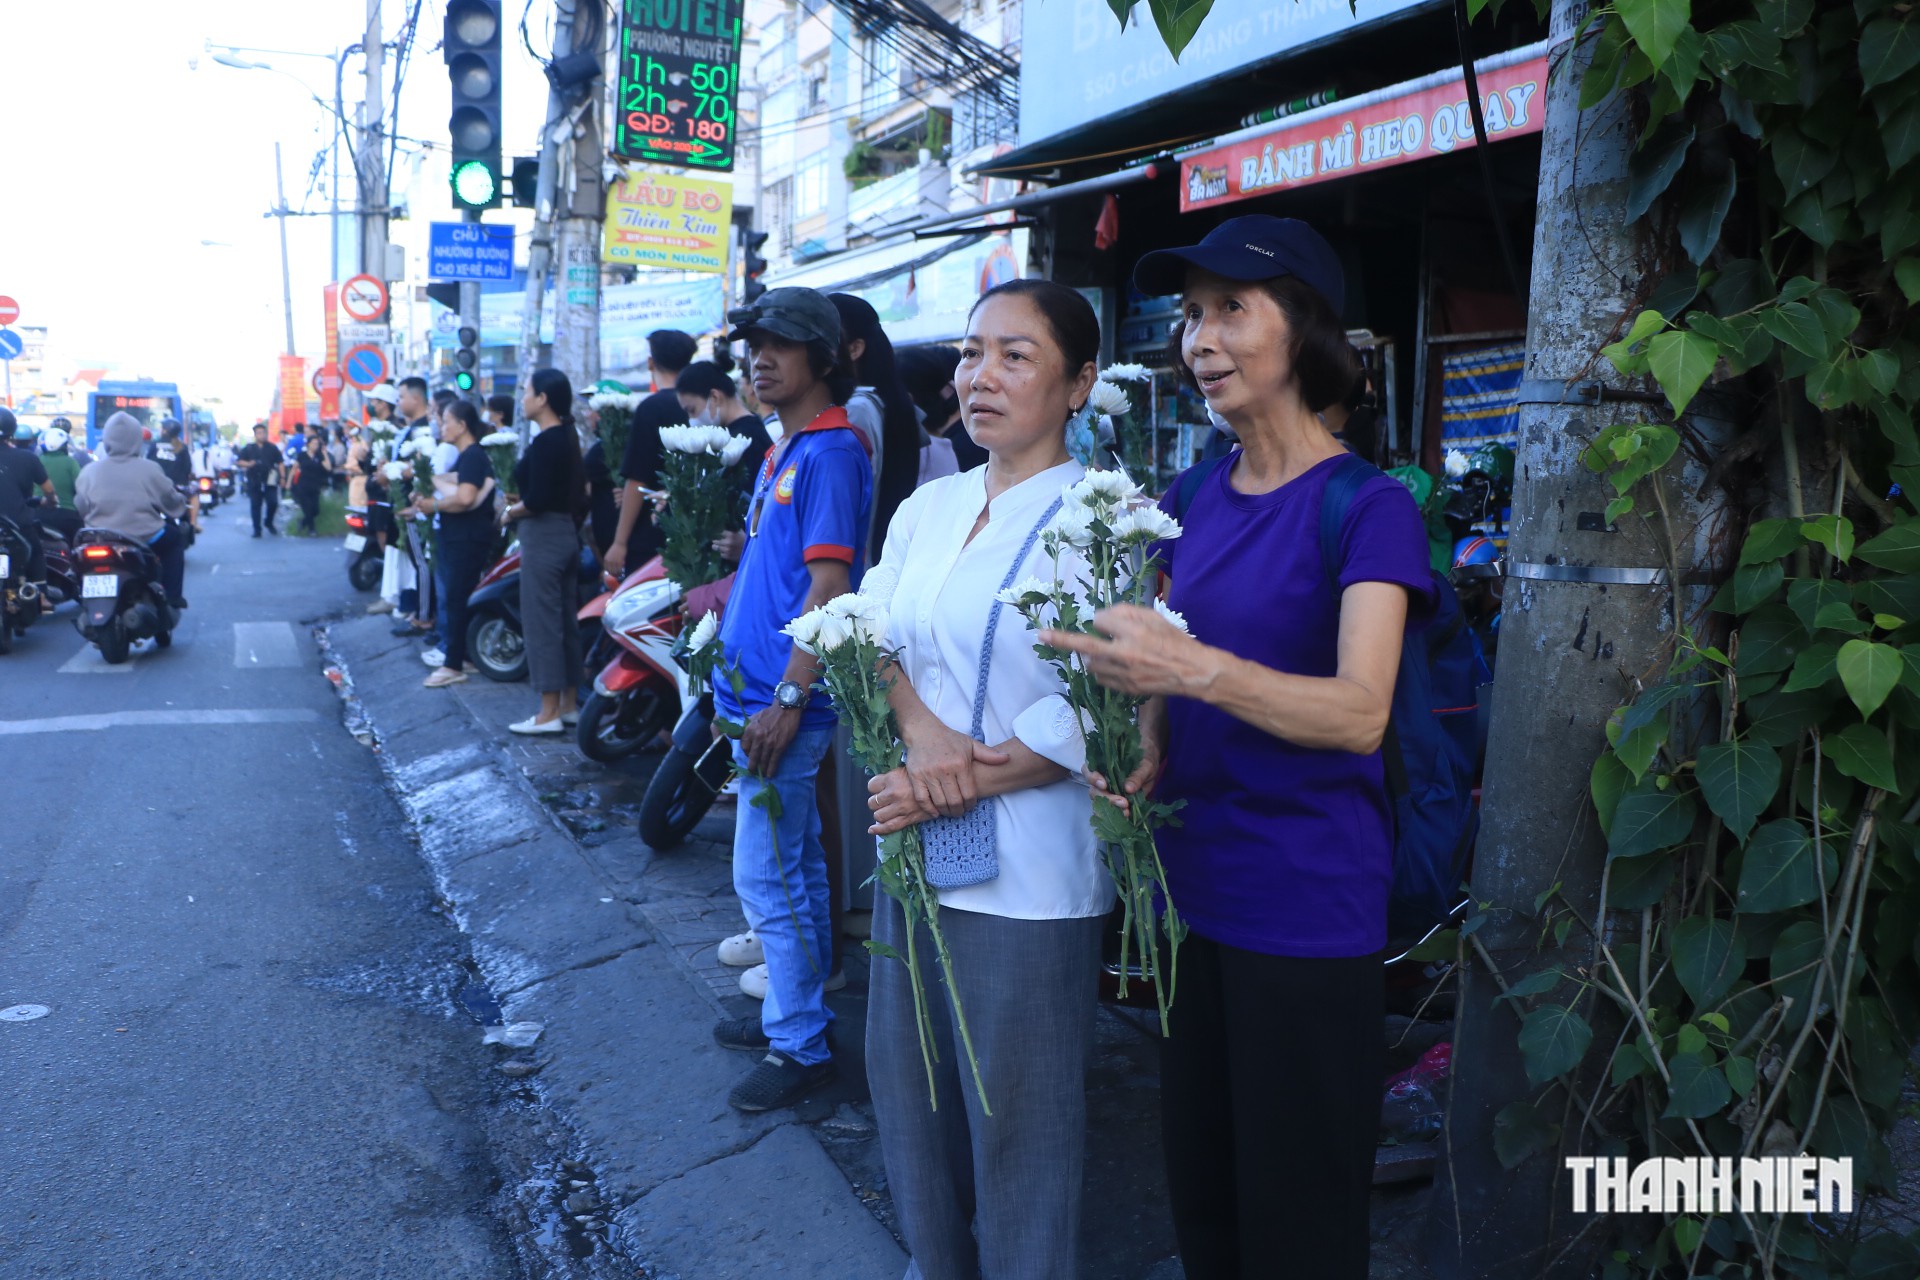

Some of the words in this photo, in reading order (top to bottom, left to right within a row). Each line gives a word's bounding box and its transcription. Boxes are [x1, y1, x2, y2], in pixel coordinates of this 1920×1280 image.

[630, 54, 666, 85] 1h
[690, 63, 729, 94] 50
[626, 83, 666, 114] 2h
[693, 92, 729, 122] 70
[686, 118, 726, 141] 180
[1240, 144, 1315, 191] BÁNH
[1320, 122, 1355, 173] MÌ
[1359, 112, 1425, 163] HEO
[1430, 82, 1537, 153] QUAY
[616, 175, 677, 208] LẨU
[682, 186, 722, 213] BÒ
[618, 207, 671, 231] Thiên
[677, 212, 719, 235] Kim
[1245, 243, 1275, 258] FORCLAZ
